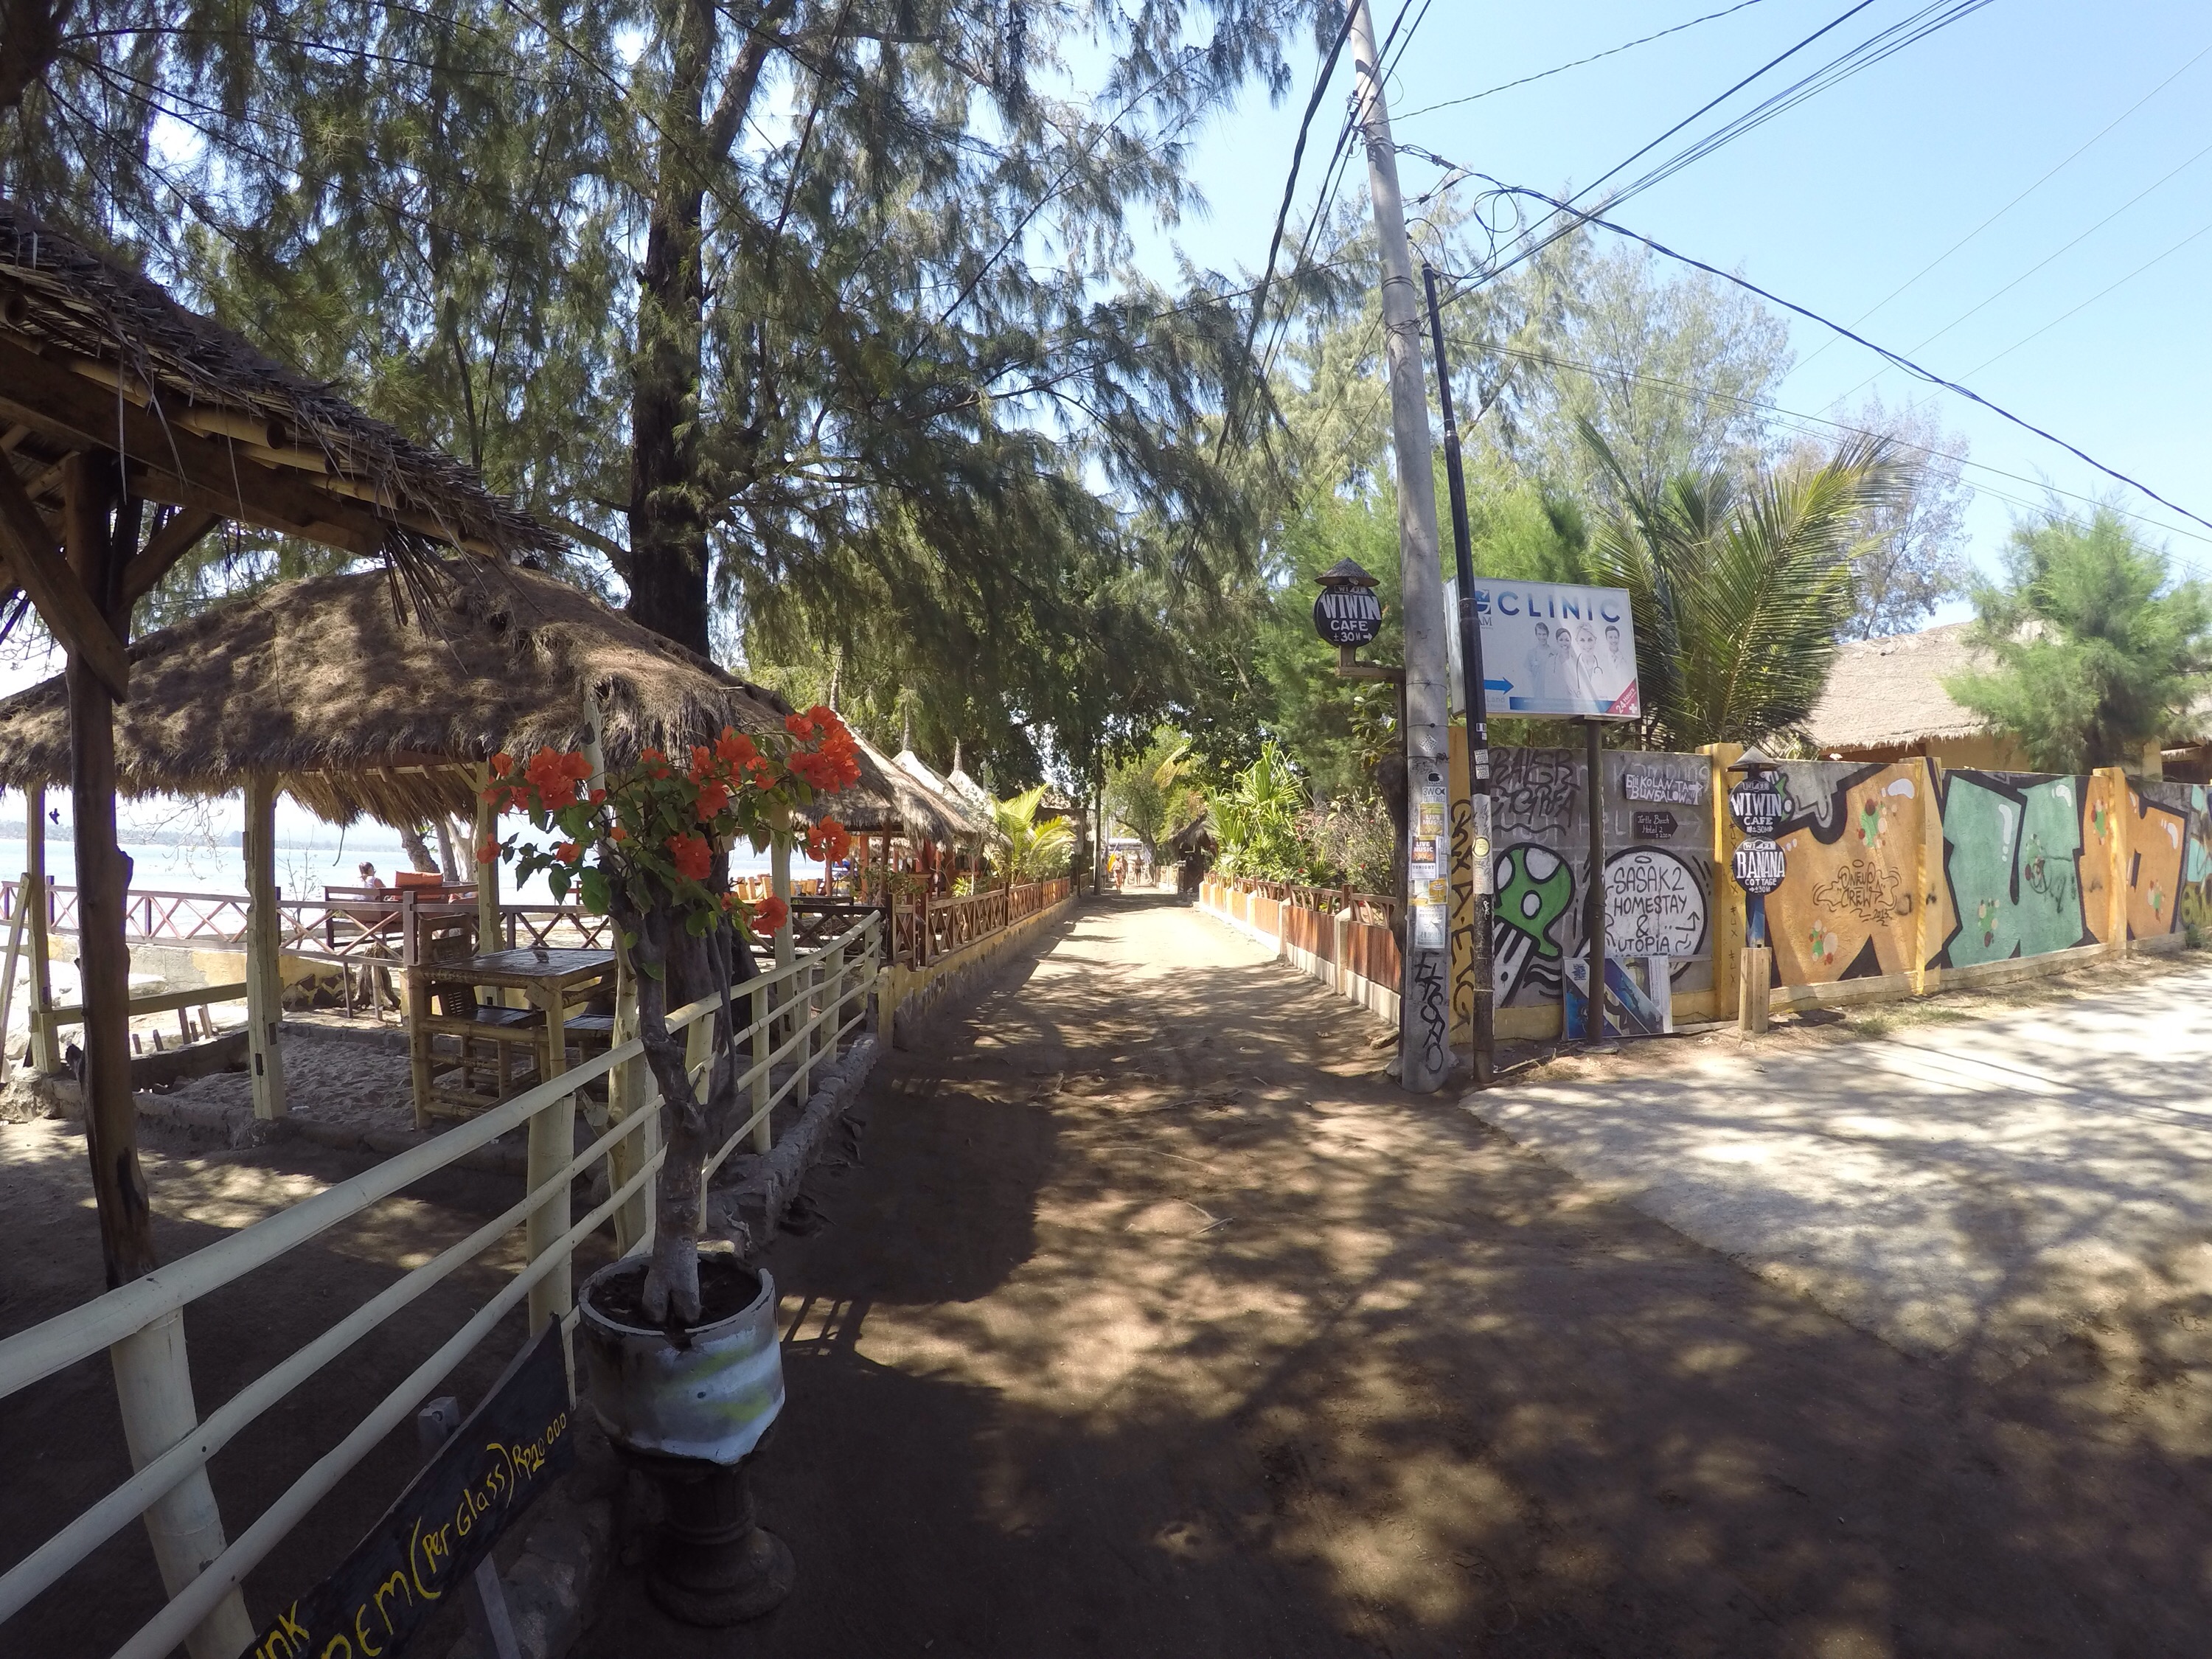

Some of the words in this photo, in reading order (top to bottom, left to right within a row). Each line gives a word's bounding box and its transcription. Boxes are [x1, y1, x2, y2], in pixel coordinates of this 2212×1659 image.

[1321, 594, 1381, 621] WIWIN
[1498, 591, 1621, 622] CLINIC
[1331, 620, 1368, 631] CAFE
[1616, 700, 1627, 714] 24
[1622, 687, 1635, 702] Hours
[1630, 786, 1687, 803] BUNGALOW
[1730, 793, 1782, 816] WIWIN
[1744, 816, 1773, 825] CAFE
[1736, 851, 1785, 879] BANANA
[1614, 866, 1670, 894] SASAK
[1672, 866, 1685, 891] 2
[1745, 878, 1777, 886] COTTAGE
[1614, 894, 1687, 917] HOMESTAY
[1841, 888, 1873, 908] CREW
[1635, 914, 1649, 938] &
